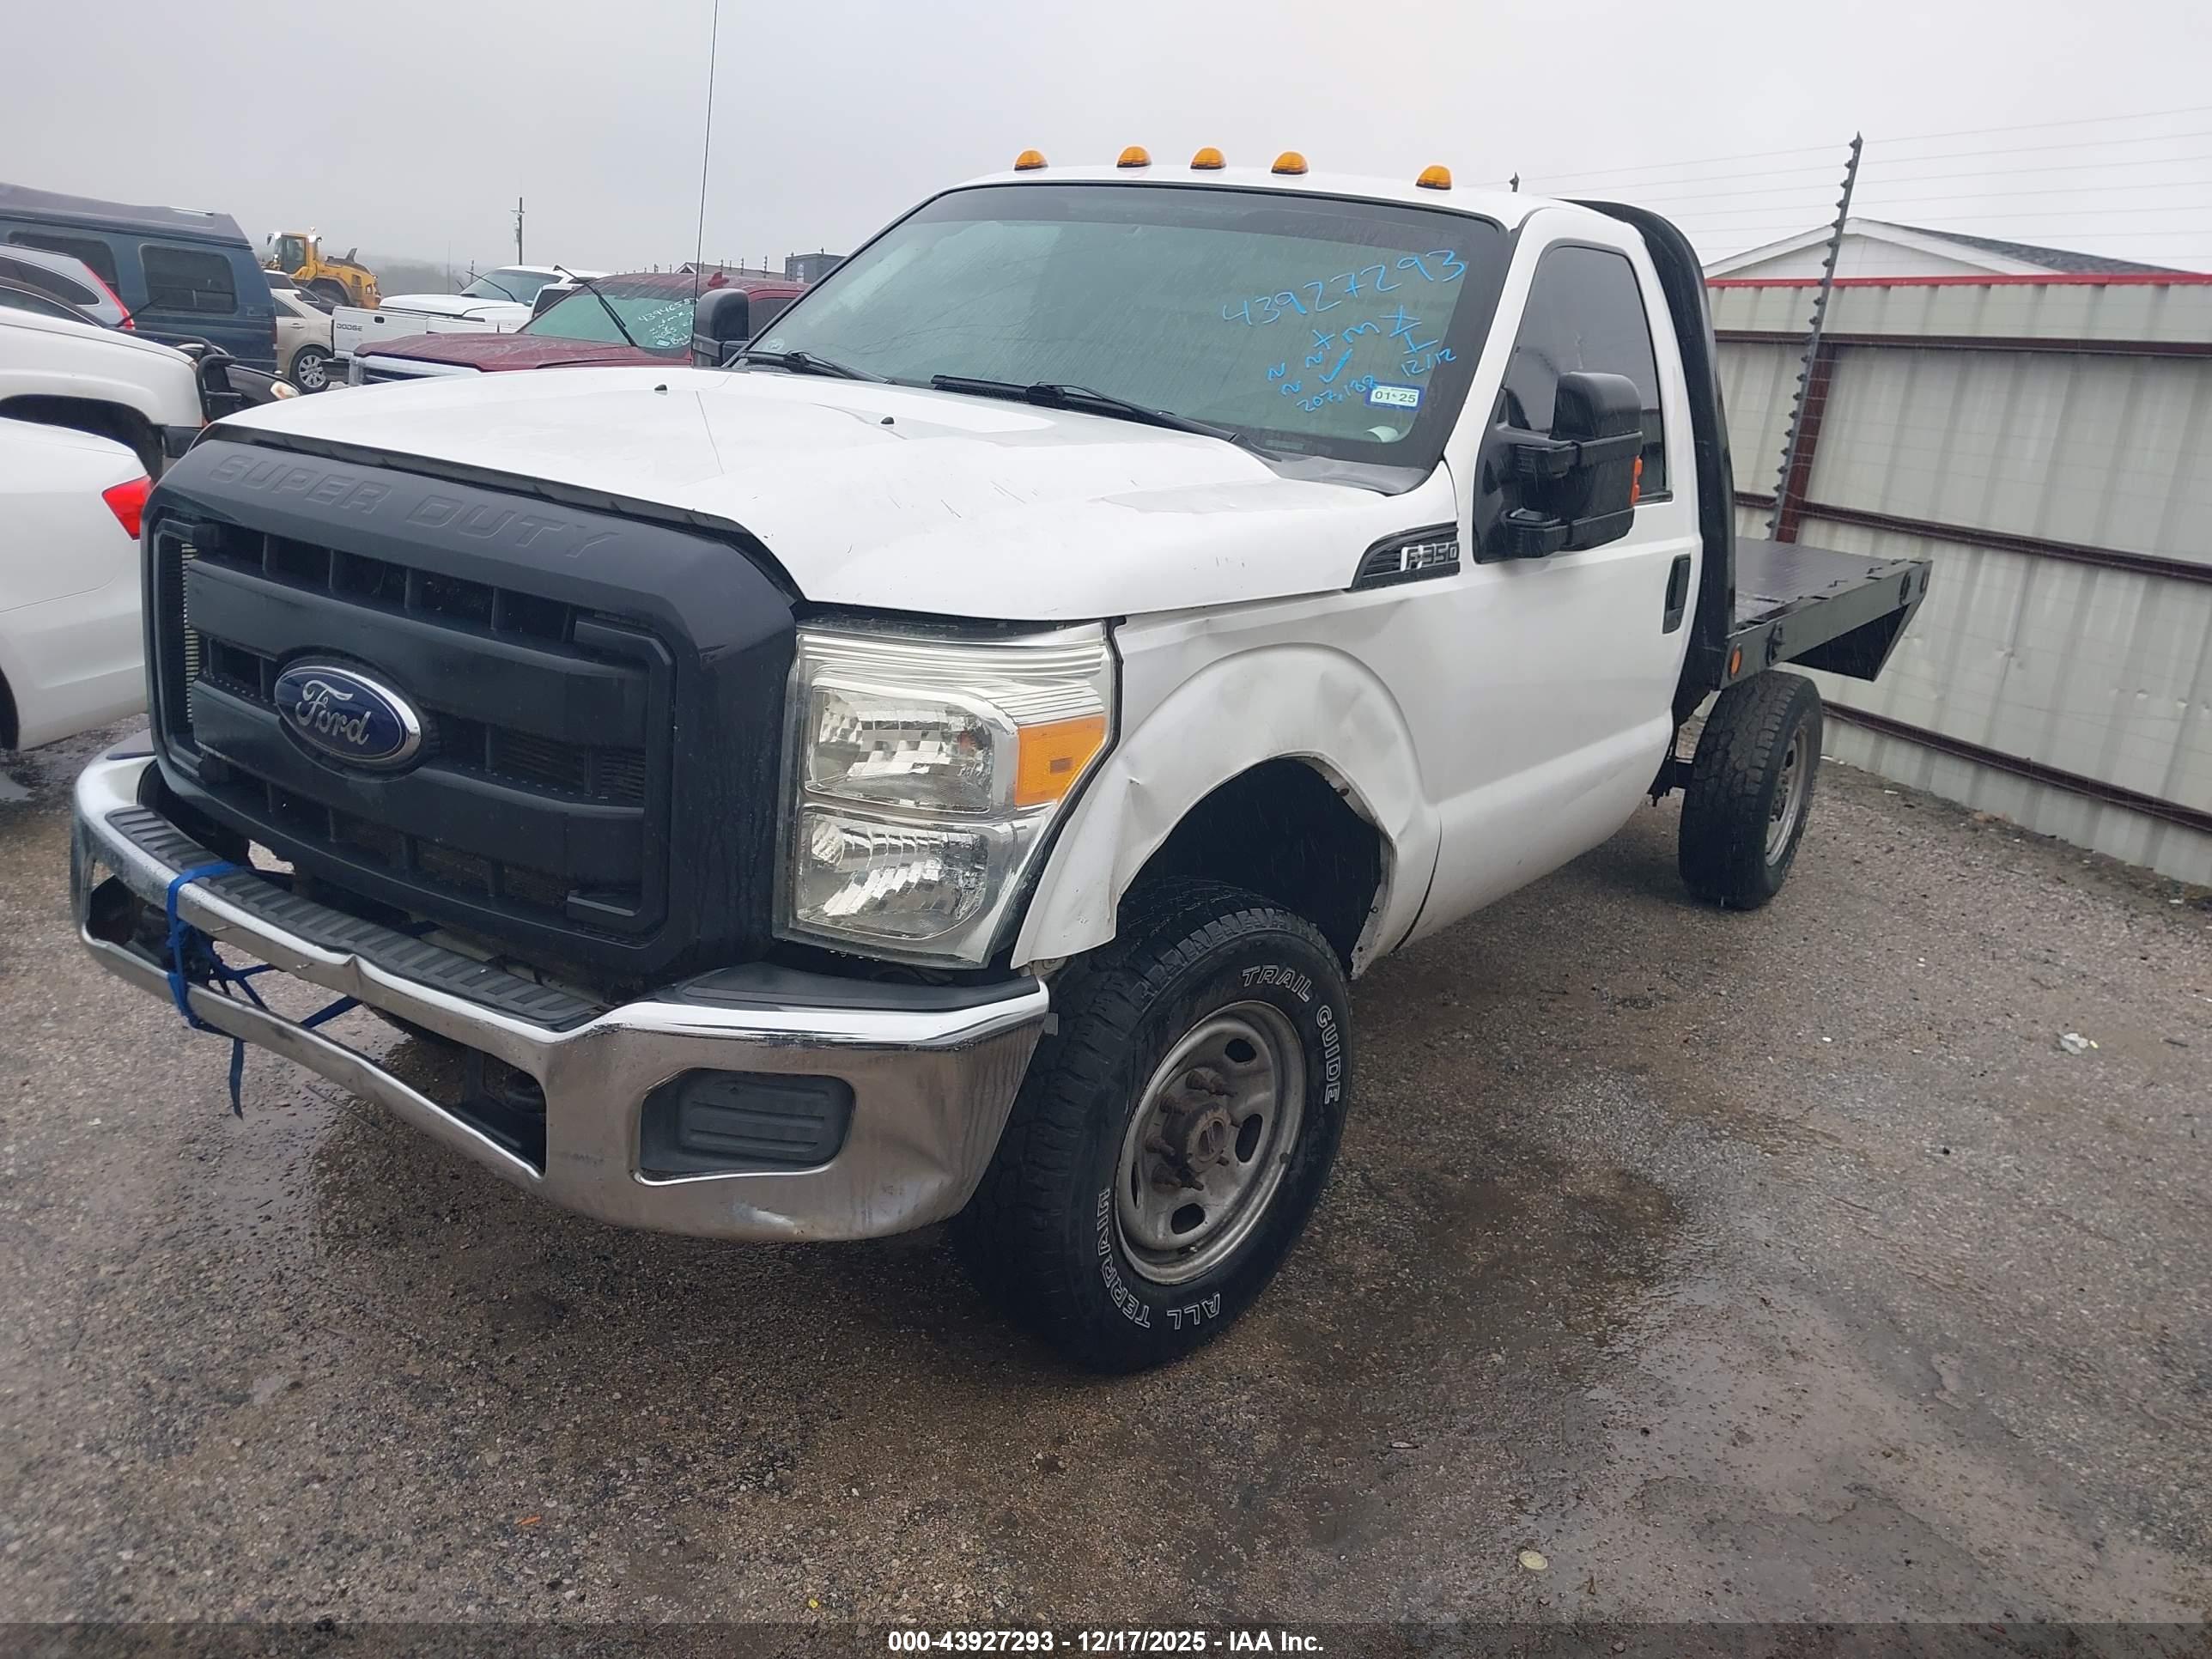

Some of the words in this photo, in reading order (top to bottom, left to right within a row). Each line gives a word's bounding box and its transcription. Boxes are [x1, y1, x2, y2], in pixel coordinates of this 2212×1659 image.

[1223, 250, 1466, 325] 43927293
[336, 323, 363, 331] DODGE
[208, 454, 392, 515] SUPER
[405, 495, 619, 558] DUTY
[295, 679, 372, 745] Ford
[1243, 964, 1313, 1002] TRAIL
[1316, 1005, 1342, 1104] GUIDE
[1097, 1188, 1152, 1329] TERRAIN
[1166, 1292, 1223, 1330] ALL
